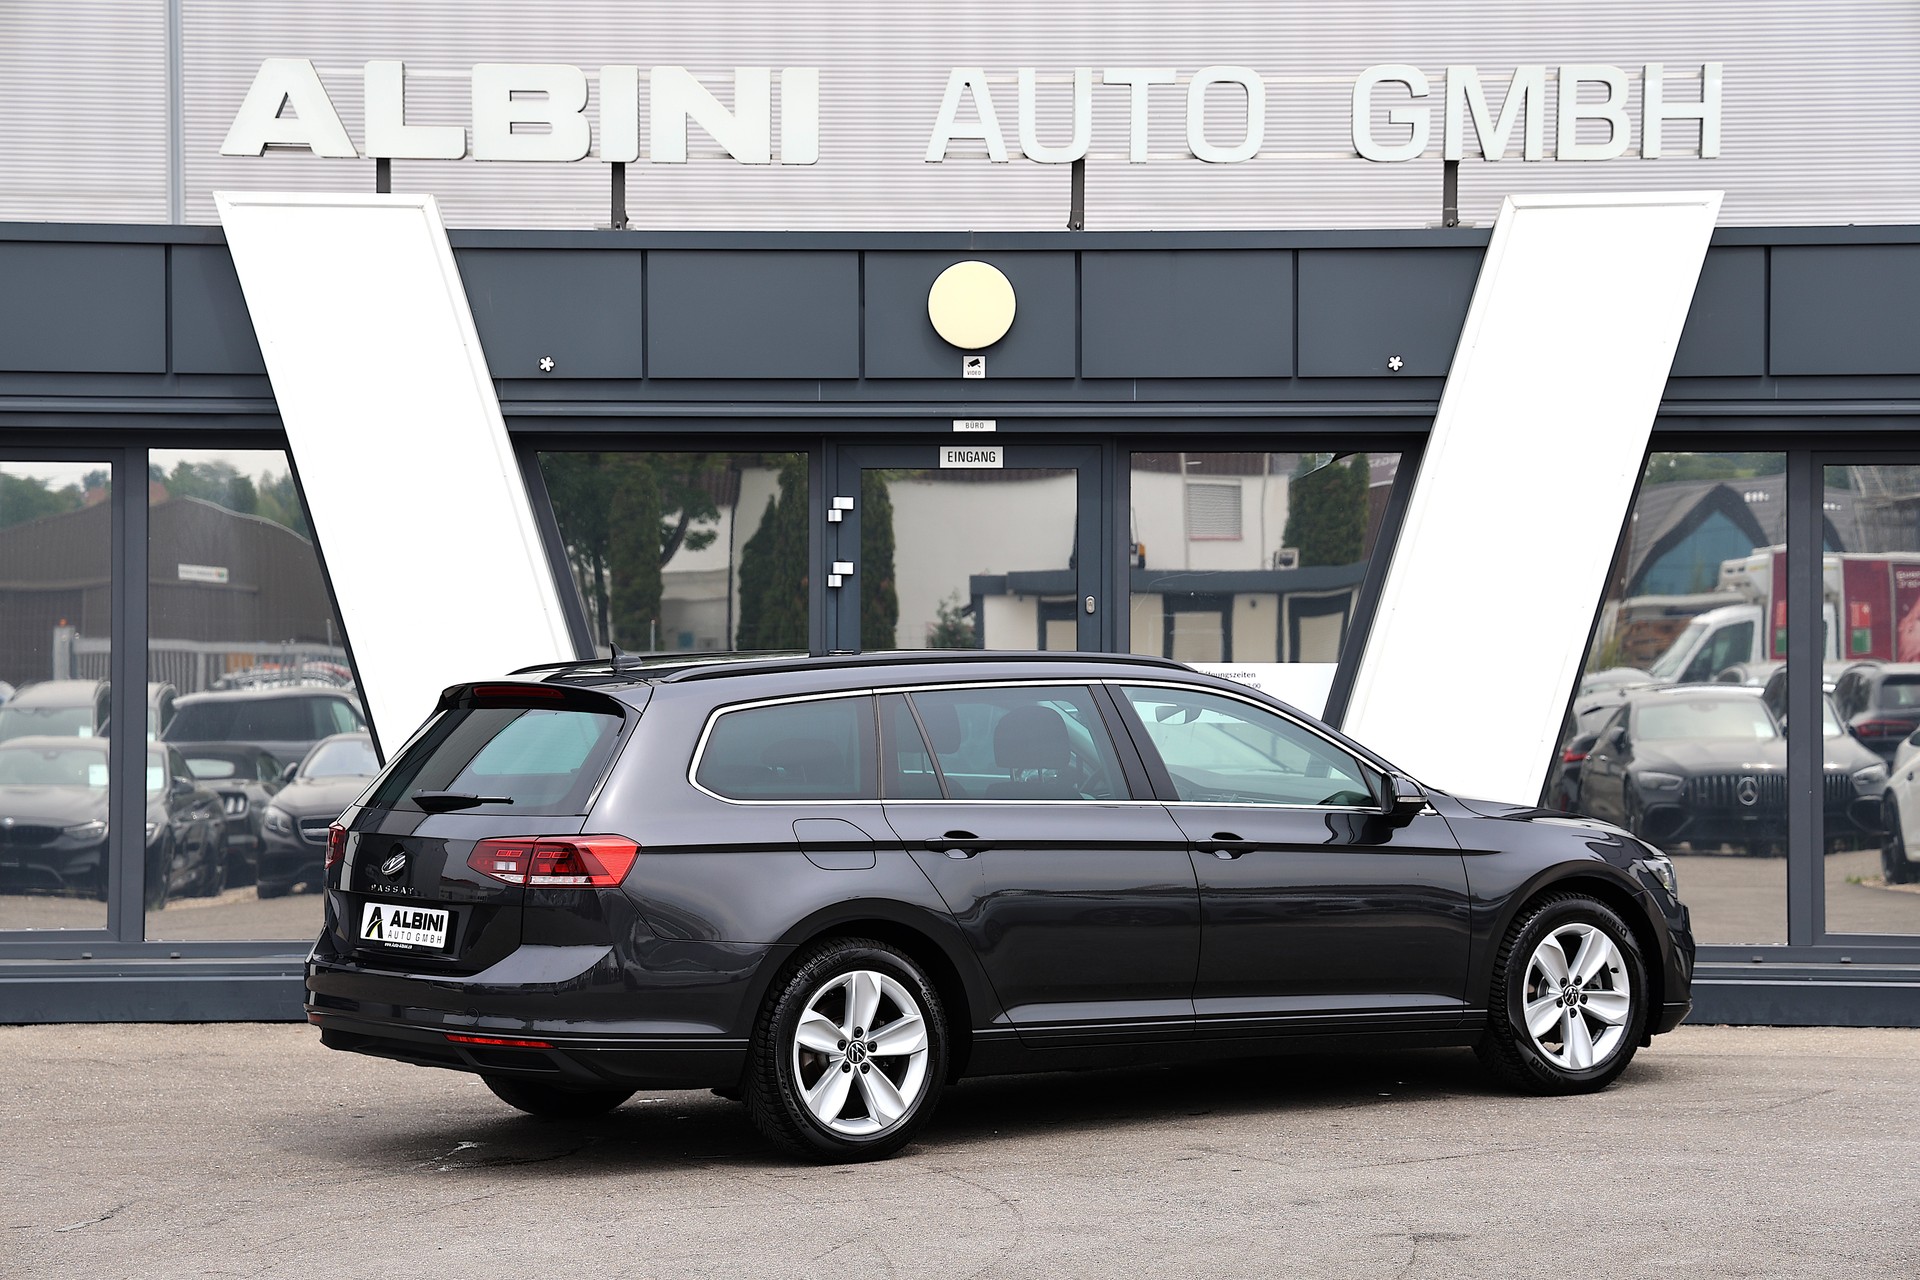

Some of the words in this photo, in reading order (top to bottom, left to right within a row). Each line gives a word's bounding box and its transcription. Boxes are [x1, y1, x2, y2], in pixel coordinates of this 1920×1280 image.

[219, 58, 819, 165] ALBINI
[925, 66, 1266, 165] AUTO
[1351, 63, 1723, 162] GMBH
[947, 451, 996, 463] EINGANG
[371, 883, 414, 895] PASSAT
[389, 910, 445, 932] ALBINI
[388, 930, 411, 941] AUTO
[415, 932, 442, 944] GMBH
